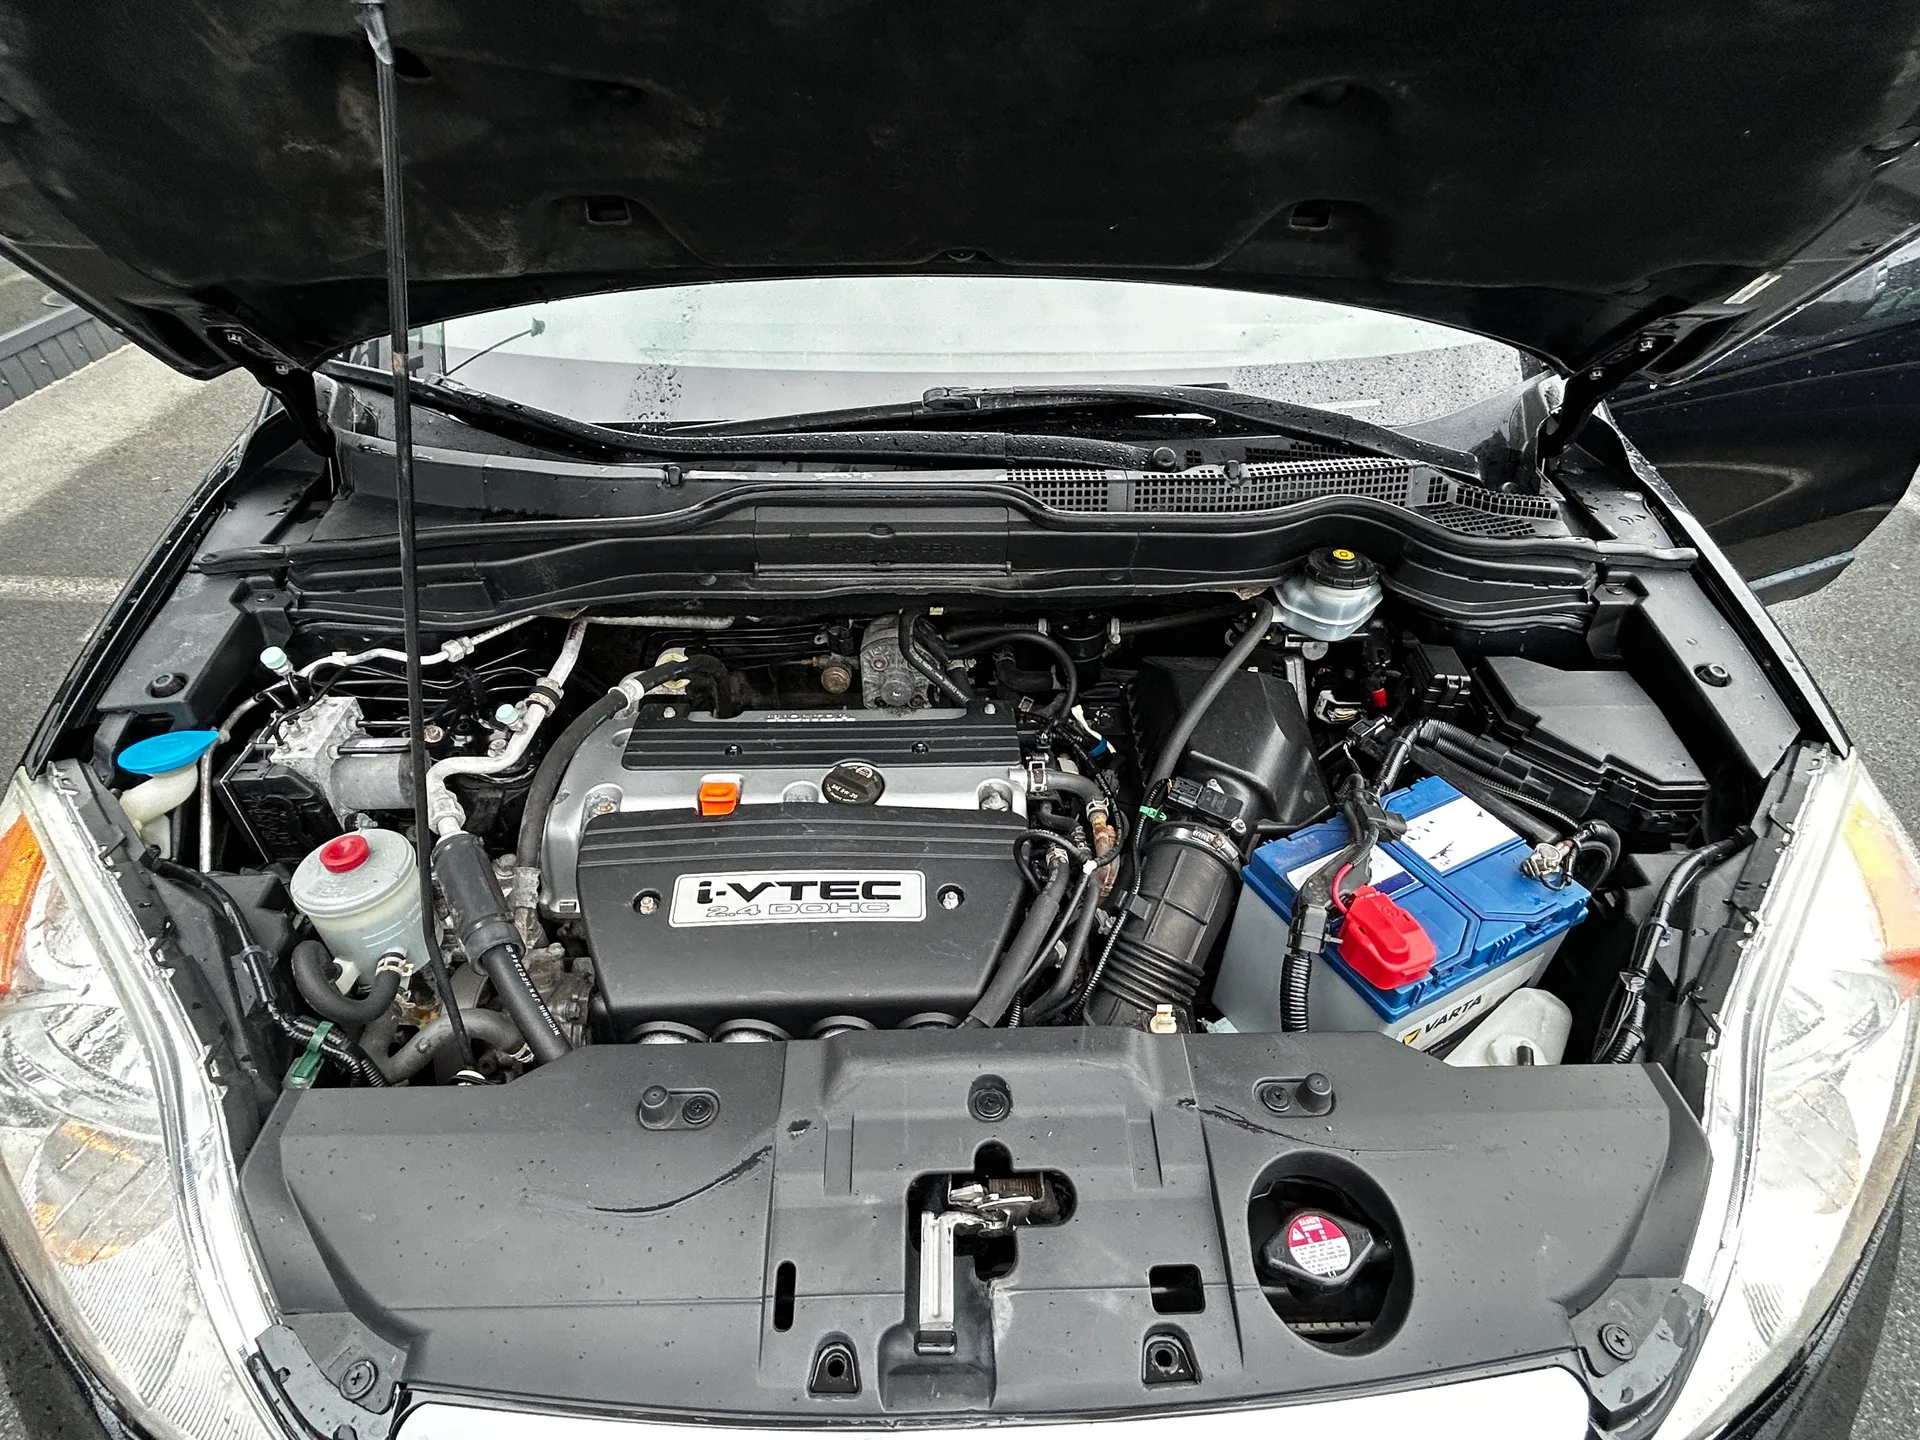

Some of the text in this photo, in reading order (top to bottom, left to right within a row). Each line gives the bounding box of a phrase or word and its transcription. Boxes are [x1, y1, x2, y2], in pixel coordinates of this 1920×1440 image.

[697, 880, 902, 904] i-VTEC
[706, 902, 890, 917] 2.4 DOHC
[539, 1004, 561, 1036] NICHIRIN
[1425, 994, 1482, 1033] VARTA
